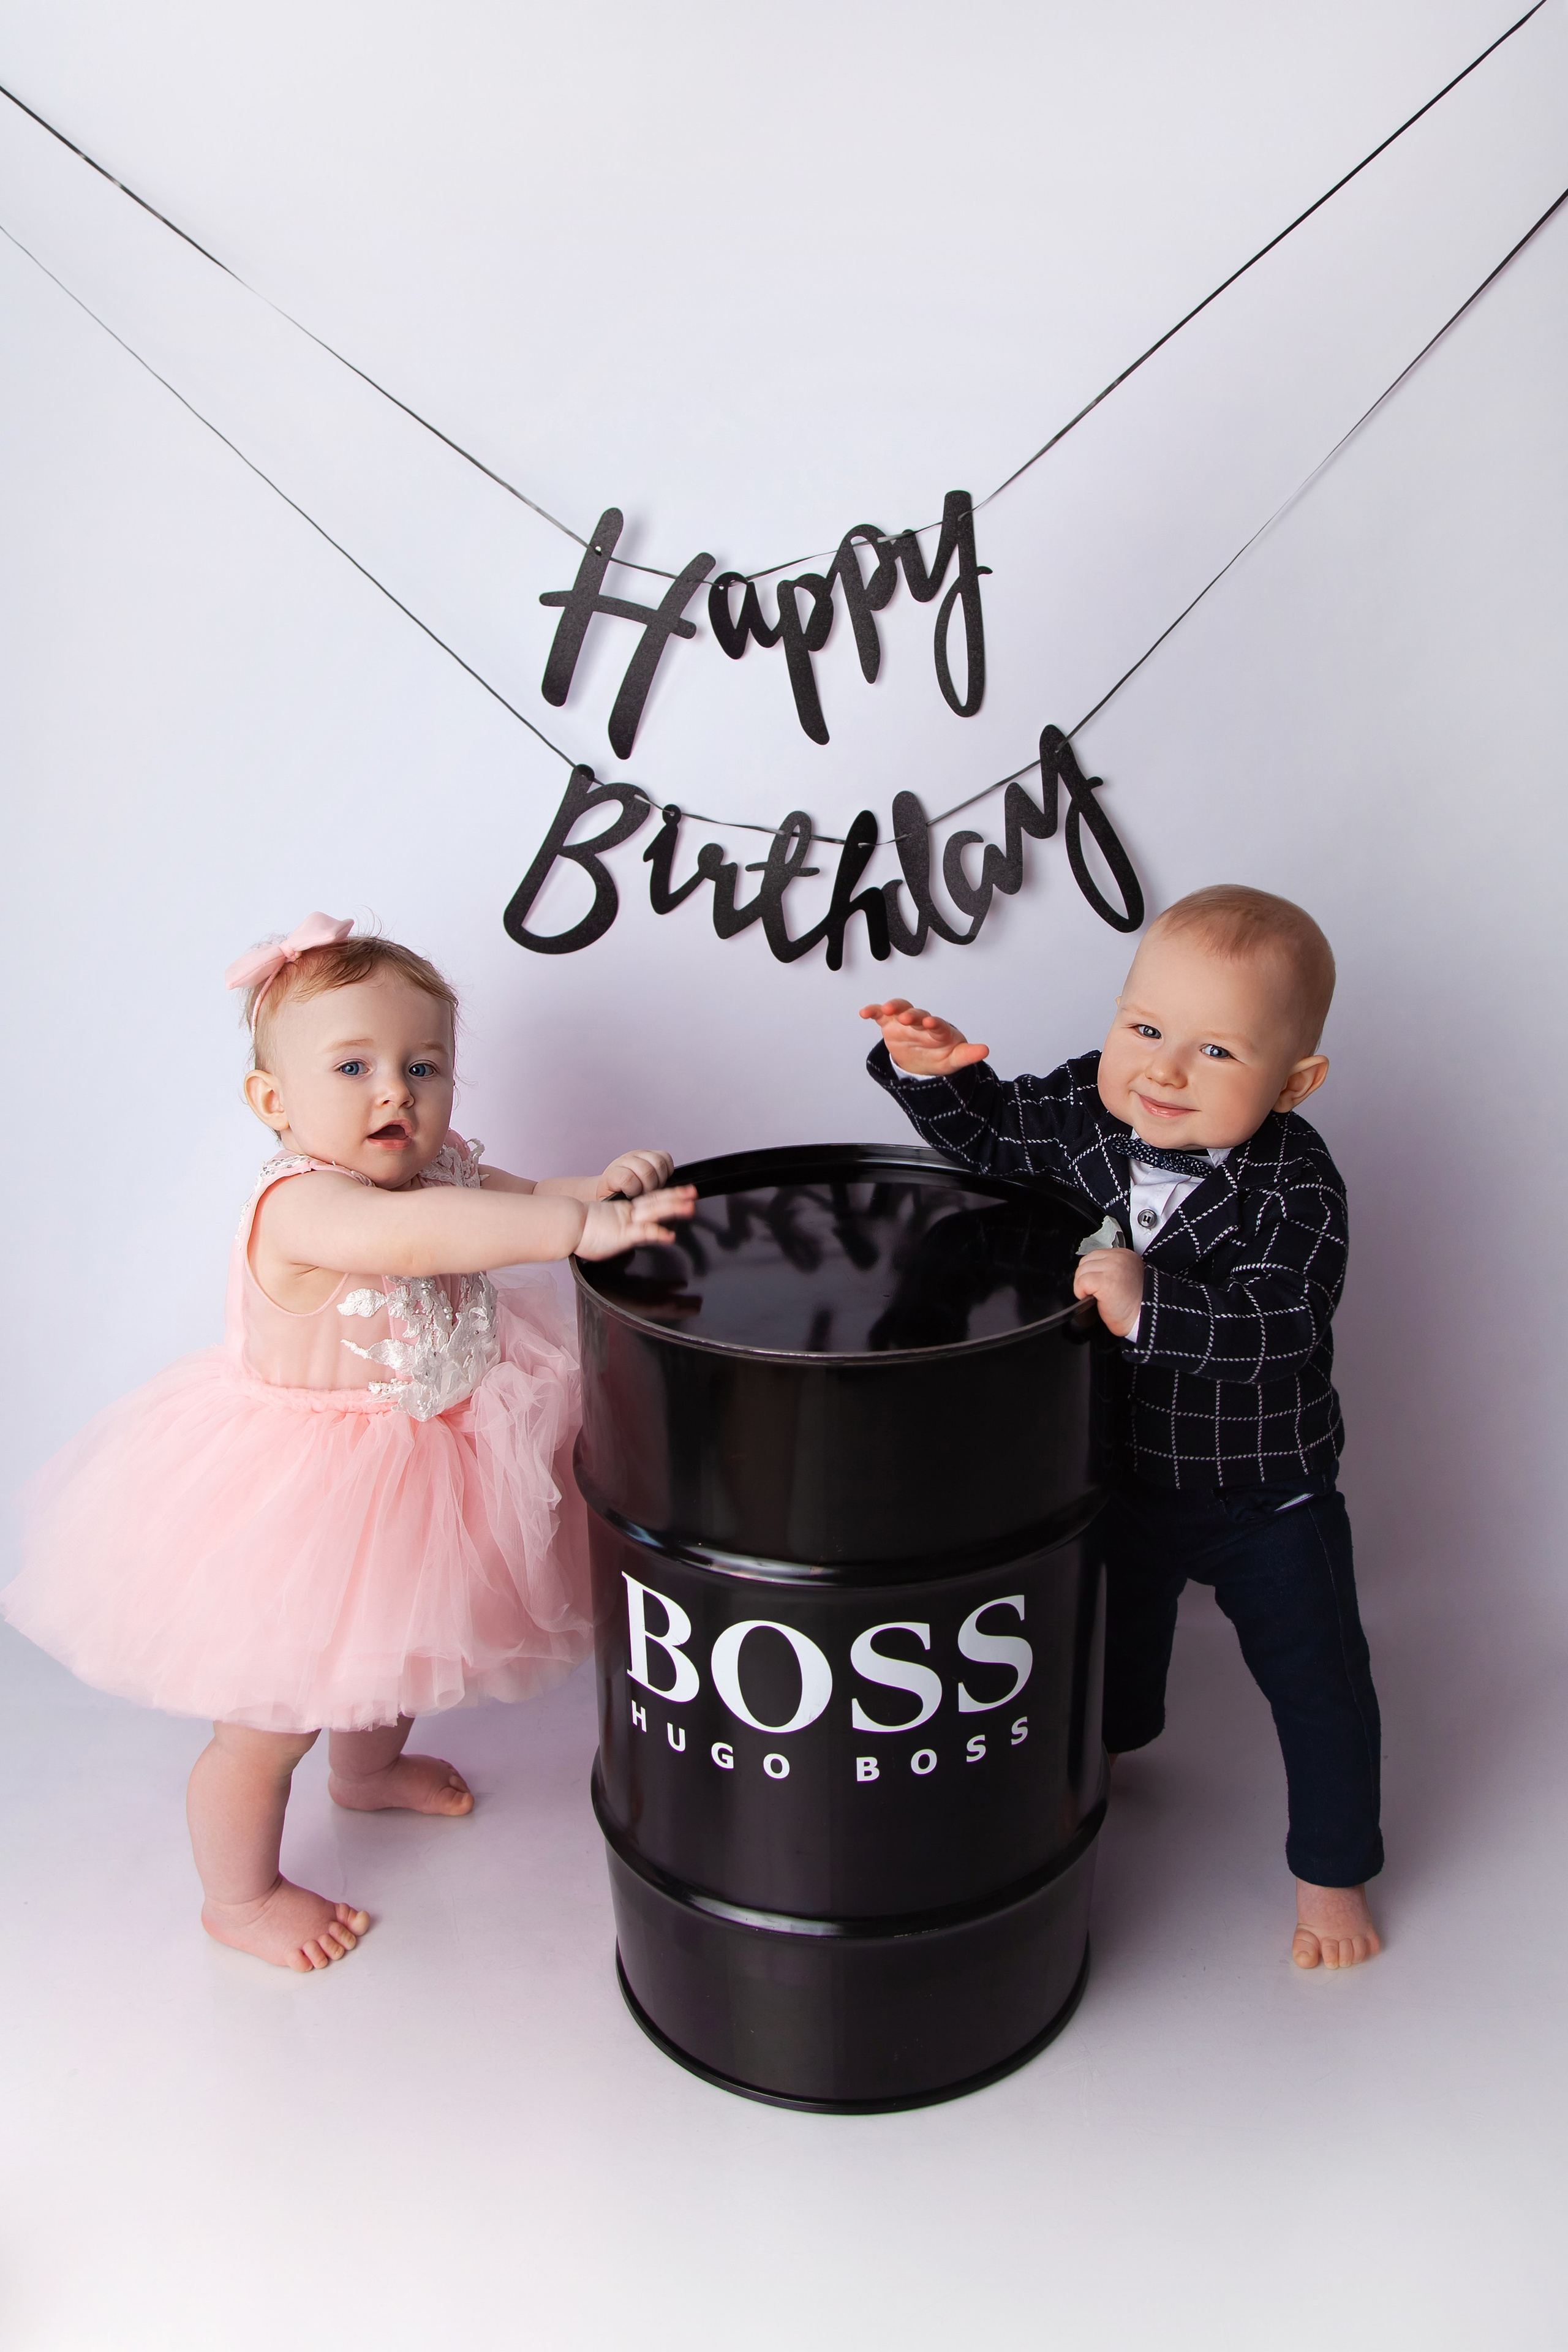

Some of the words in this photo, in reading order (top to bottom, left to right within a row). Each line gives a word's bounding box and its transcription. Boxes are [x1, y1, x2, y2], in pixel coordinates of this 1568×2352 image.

[539, 490, 992, 760] Happy
[503, 724, 1144, 971] Birthday
[621, 1570, 1033, 1733] BOSS
[631, 1700, 790, 1779] HUGO
[856, 1716, 1028, 1781] BOSS
